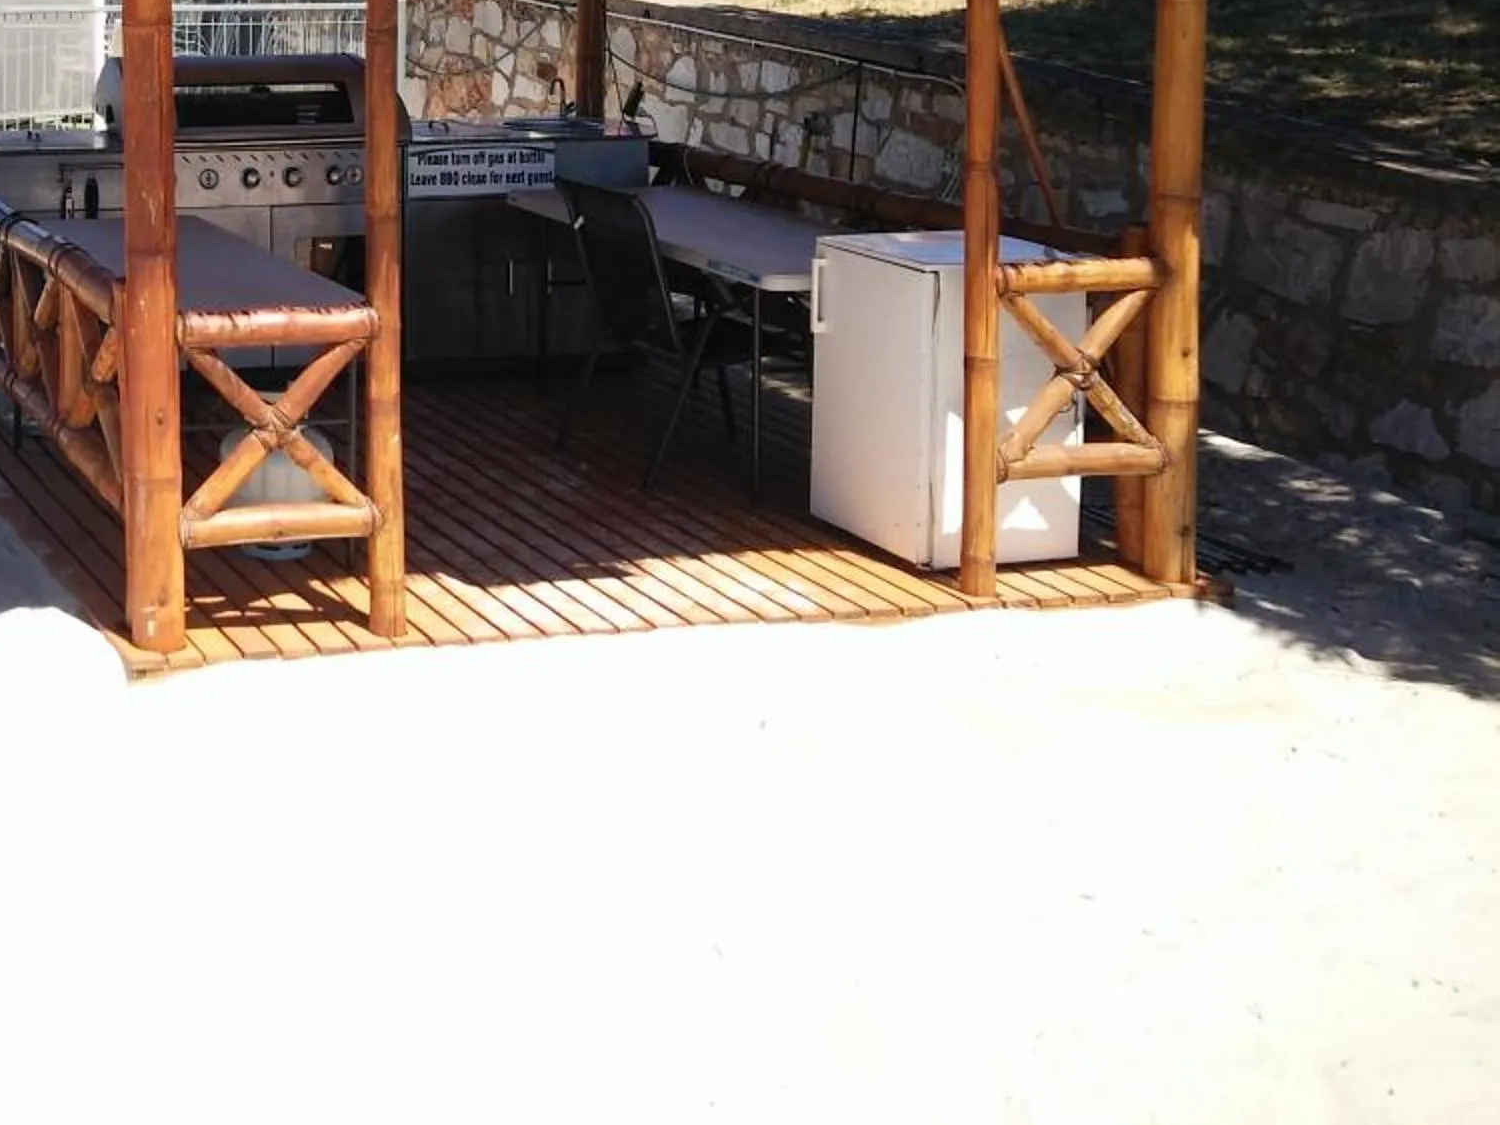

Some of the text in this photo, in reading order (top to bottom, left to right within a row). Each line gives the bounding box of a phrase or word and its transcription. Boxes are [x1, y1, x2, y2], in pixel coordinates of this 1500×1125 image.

[417, 153, 449, 166] Please
[451, 151, 470, 166] turn
[472, 150, 485, 165] off
[488, 154, 505, 167] gas
[507, 151, 517, 164] at
[410, 173, 437, 186] Leave
[440, 172, 459, 187] BBQ
[461, 171, 487, 185] clean
[489, 170, 503, 184] for
[505, 171, 525, 184] next
